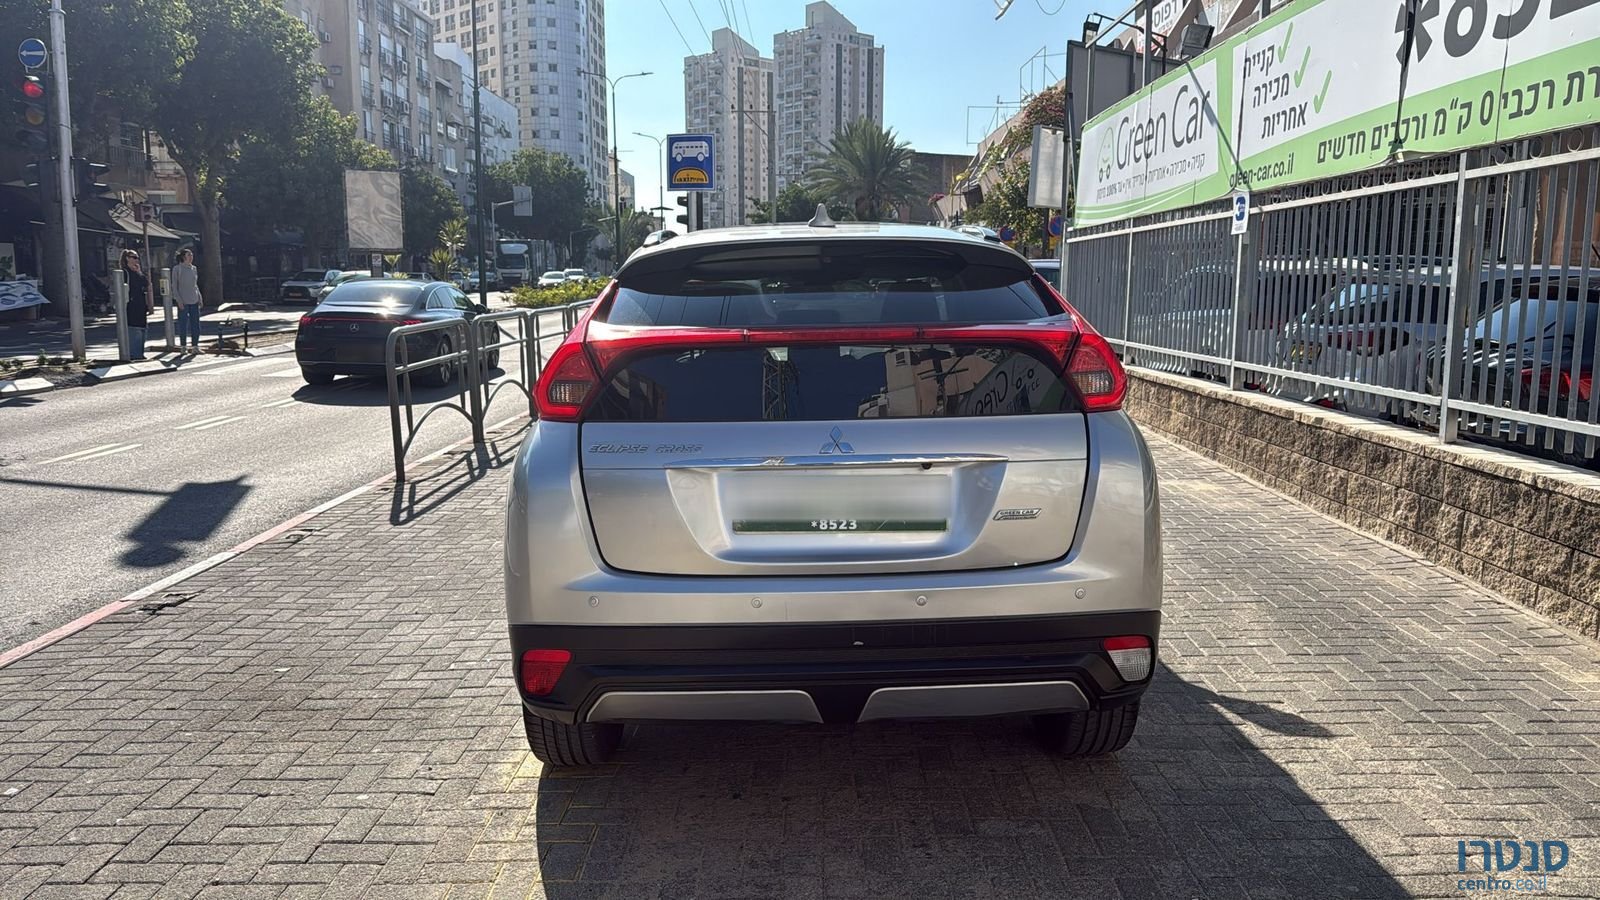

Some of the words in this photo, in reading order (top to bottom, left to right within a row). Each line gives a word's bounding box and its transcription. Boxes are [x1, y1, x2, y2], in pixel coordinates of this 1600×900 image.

[1253, 72, 1290, 108] מכירה
[1502, 79, 1555, 120] רכבי
[1116, 112, 1166, 170] Green
[1172, 85, 1210, 148] Car
[1262, 101, 1308, 139] אחריות
[1317, 130, 1366, 164] חדשים
[1229, 153, 1294, 188] geen-car.co.il
[588, 444, 629, 454] ECLIPSE
[655, 444, 704, 454] CROSS
